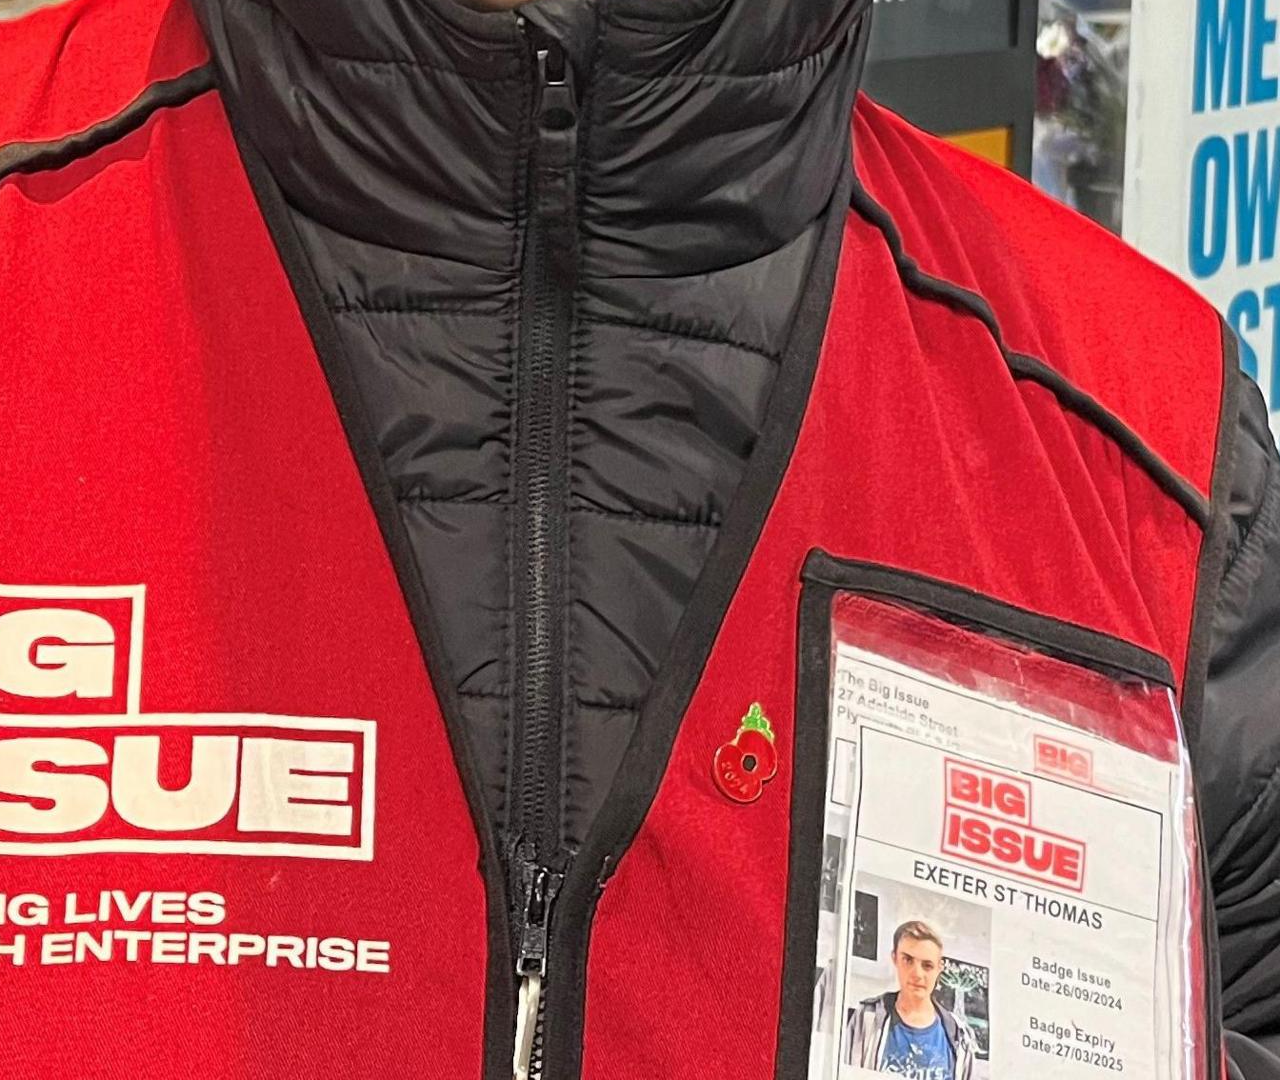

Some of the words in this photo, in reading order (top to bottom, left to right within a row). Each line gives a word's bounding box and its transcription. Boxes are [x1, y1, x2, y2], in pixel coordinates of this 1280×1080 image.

[837, 687, 855, 700] 27
[868, 677, 891, 700] Big
[894, 685, 930, 710] Issue
[1036, 740, 1091, 775] BIG
[950, 766, 1027, 816] BIG
[947, 814, 1080, 882] ISSUE
[64, 889, 227, 925] LIVES
[913, 859, 989, 900] EXETER
[994, 885, 1019, 907] ST
[1020, 890, 1104, 931] THOMAS
[41, 930, 392, 975] ENTERPRISE
[1021, 971, 1124, 1011] Date:26/09/2024
[1031, 955, 1074, 981] Badge
[1077, 966, 1112, 990] Issue
[1021, 1033, 1125, 1073] Date:27/03/2025
[1029, 1015, 1072, 1041] Badge
[1075, 1027, 1117, 1053] Expiry
